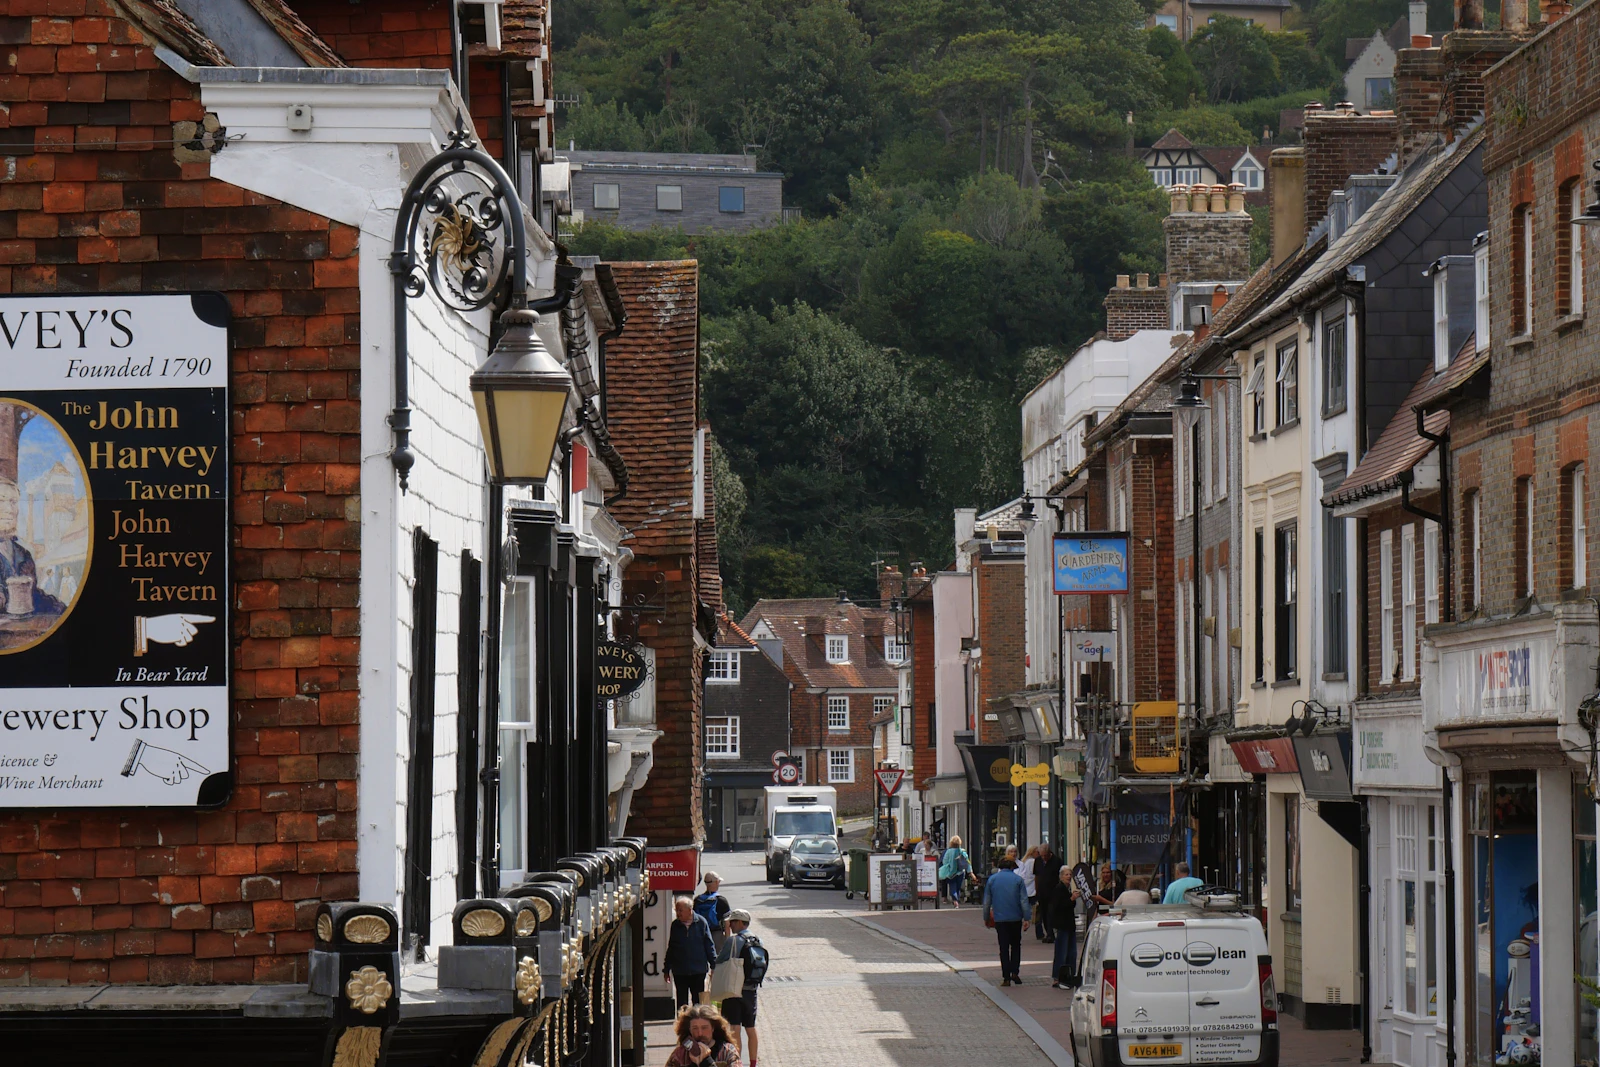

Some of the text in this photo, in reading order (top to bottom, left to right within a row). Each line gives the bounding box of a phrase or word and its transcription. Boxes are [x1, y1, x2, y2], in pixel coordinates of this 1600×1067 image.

[0, 309, 134, 350] VEY'S
[65, 356, 212, 378] Founded 1790
[61, 401, 179, 430] The John
[90, 441, 217, 476] Harvey
[125, 480, 210, 500] Tavern
[108, 508, 171, 540] John
[1080, 540, 1100, 551] The
[118, 544, 212, 575] Harvey
[1061, 551, 1121, 568] GARDENER'S
[1081, 565, 1107, 583] ARMS
[131, 577, 217, 601] Tavern
[1084, 646, 1100, 655] age
[115, 666, 209, 682] In Bear Yard
[598, 666, 641, 679] WERY
[1487, 647, 1530, 690] INTERSPORT
[597, 684, 621, 695] HOP
[119, 695, 210, 741] Shop
[43, 753, 58, 767] &
[782, 768, 796, 777] 20
[0, 775, 104, 789] Wine Merchant
[1119, 813, 1182, 826] VAPE SH
[1120, 834, 1143, 844] OPEN
[1144, 834, 1156, 844] AS
[1077, 868, 1093, 900] VAPE
[1146, 970, 1164, 978] pure
[1189, 967, 1231, 977] technology
[1133, 1046, 1158, 1056] AV64
